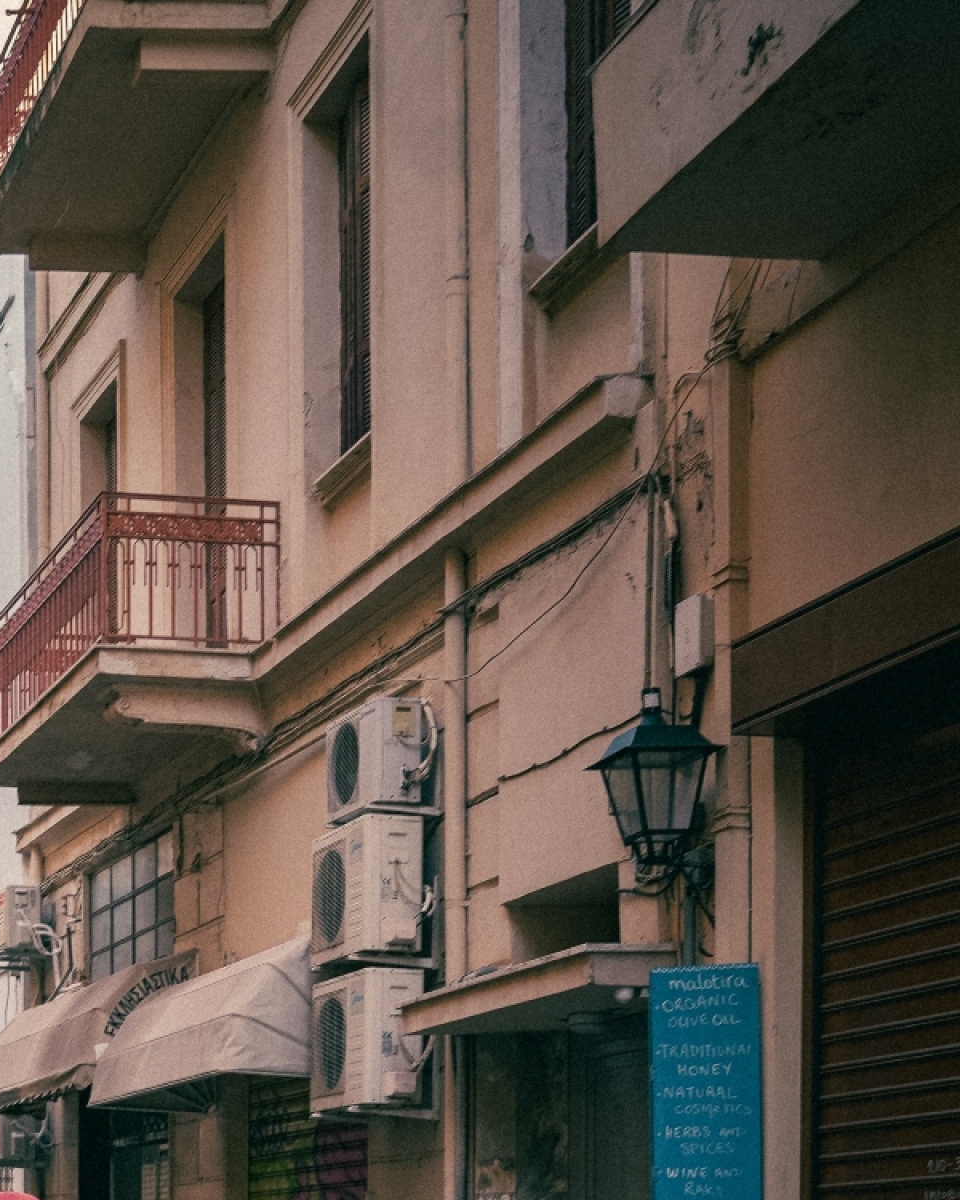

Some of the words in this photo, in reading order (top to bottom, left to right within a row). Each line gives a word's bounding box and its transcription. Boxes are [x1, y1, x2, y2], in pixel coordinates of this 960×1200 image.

[661, 993, 740, 1013] ORGANIC
[667, 1013, 709, 1028] OLIVE
[711, 1013, 743, 1027] OIL
[677, 1062, 733, 1077] HONEY
[663, 1085, 739, 1100] NATURAL
[664, 1125, 711, 1140] HERBS
[719, 1126, 747, 1138] AND
[680, 1142, 736, 1156] SPICES
[665, 1166, 709, 1179] WINE
[714, 1167, 744, 1178] AND
